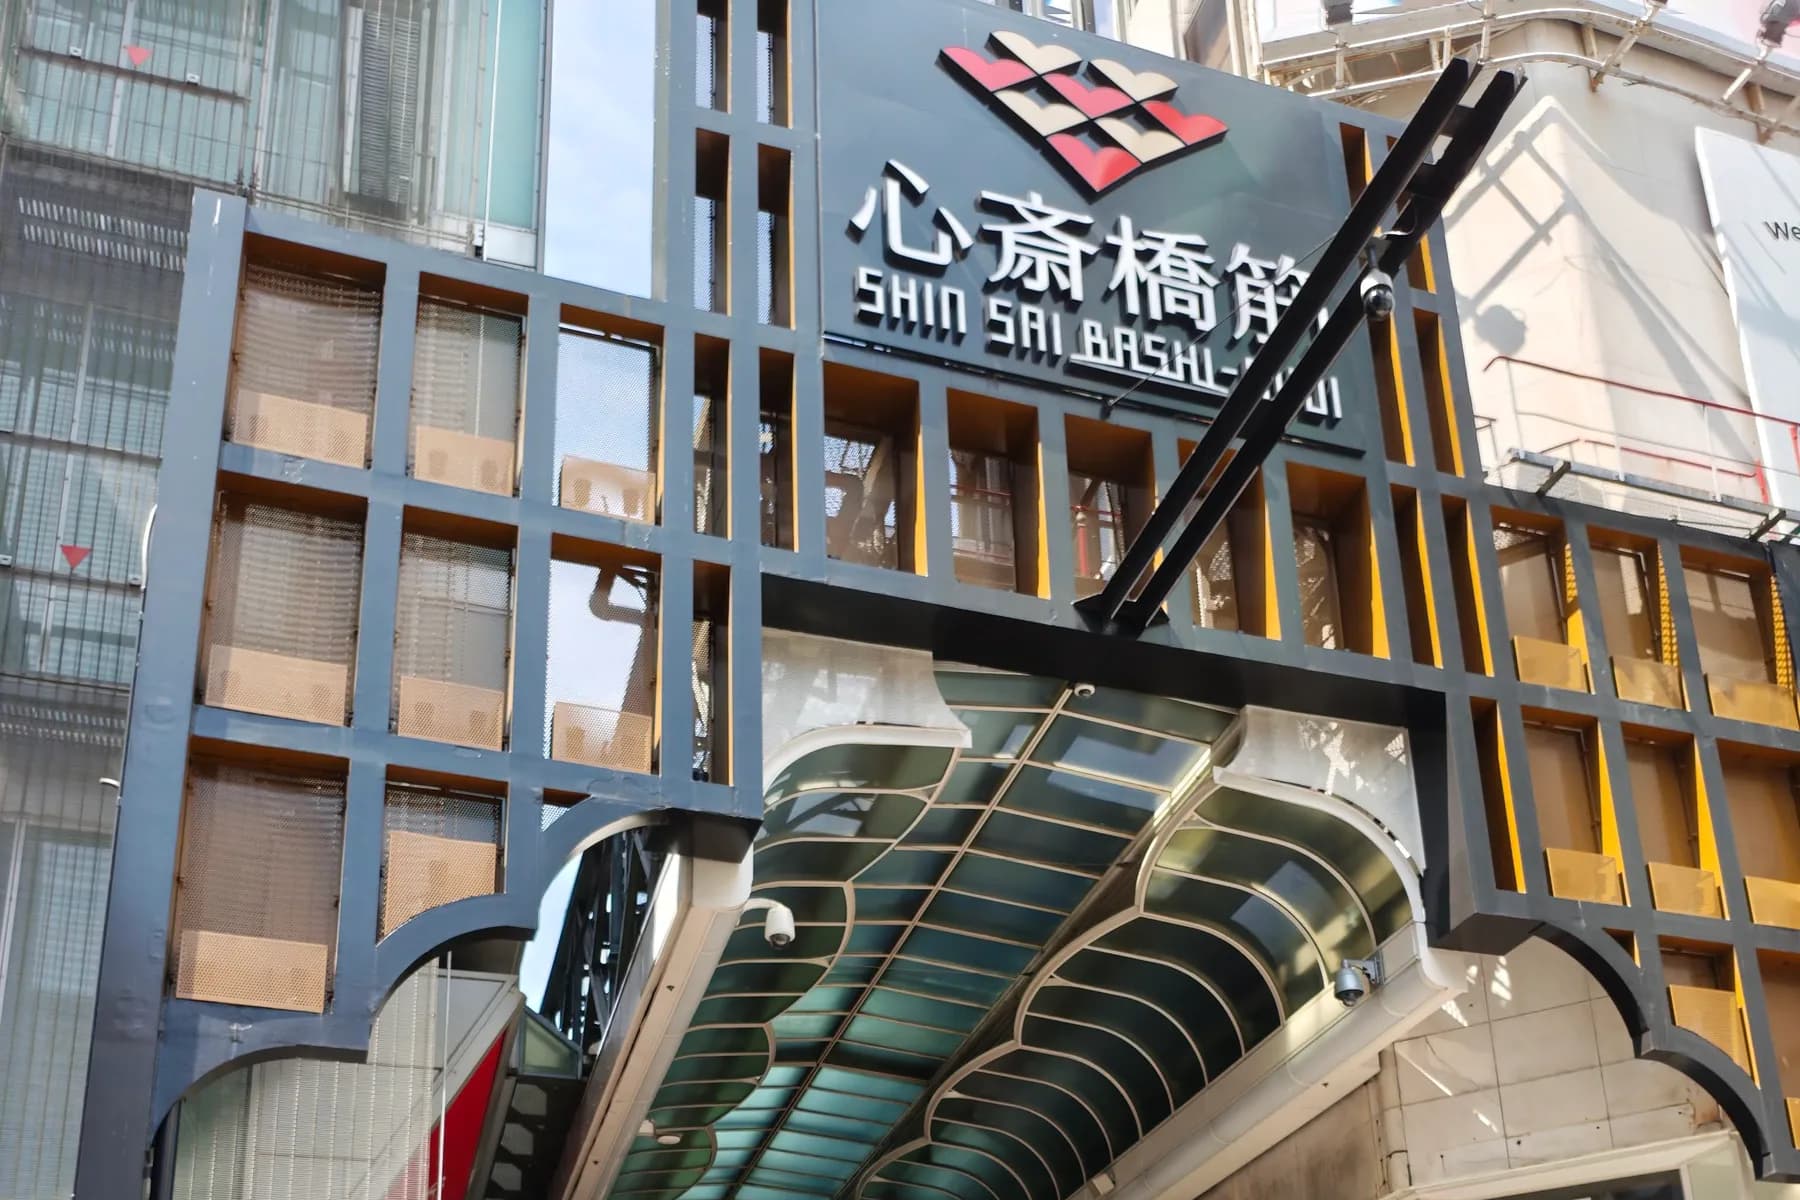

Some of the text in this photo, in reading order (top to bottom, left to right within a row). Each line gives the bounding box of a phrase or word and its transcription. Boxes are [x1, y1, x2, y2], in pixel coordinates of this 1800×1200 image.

[855, 266, 1343, 420] SHIN SAI BASHI-JI
